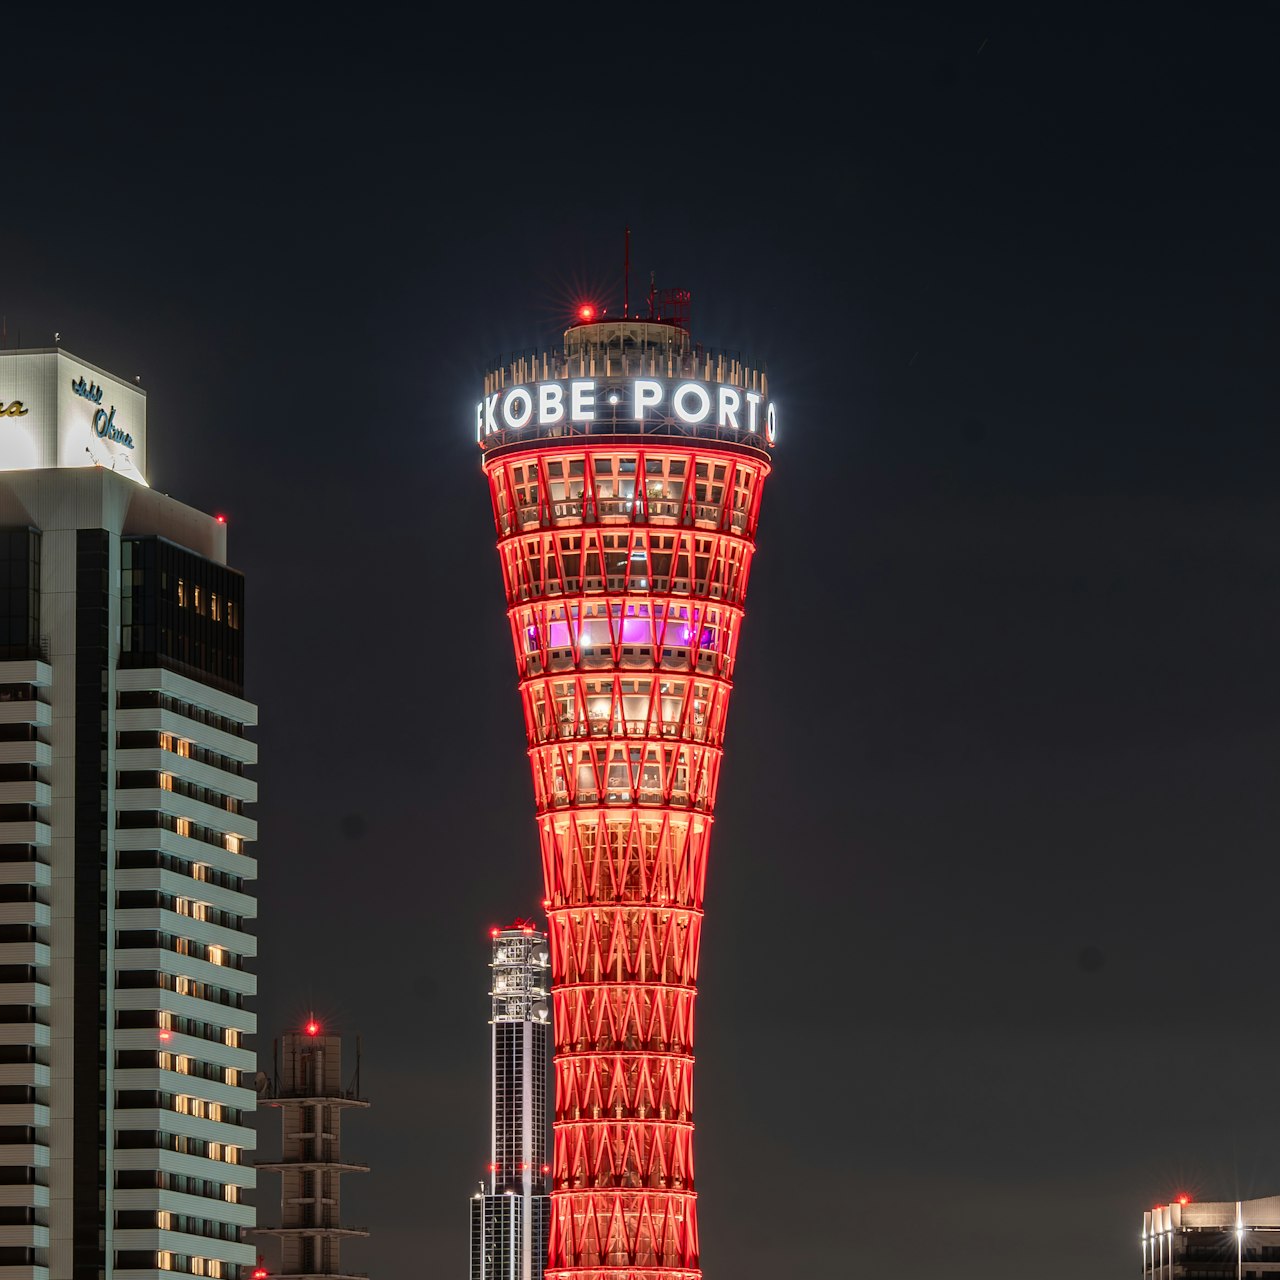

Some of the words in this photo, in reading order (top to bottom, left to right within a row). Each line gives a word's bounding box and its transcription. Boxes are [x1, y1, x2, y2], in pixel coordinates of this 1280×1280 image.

[94, 405, 135, 450] Okura
[484, 380, 597, 436] KOBE
[634, 379, 761, 434] PORT
